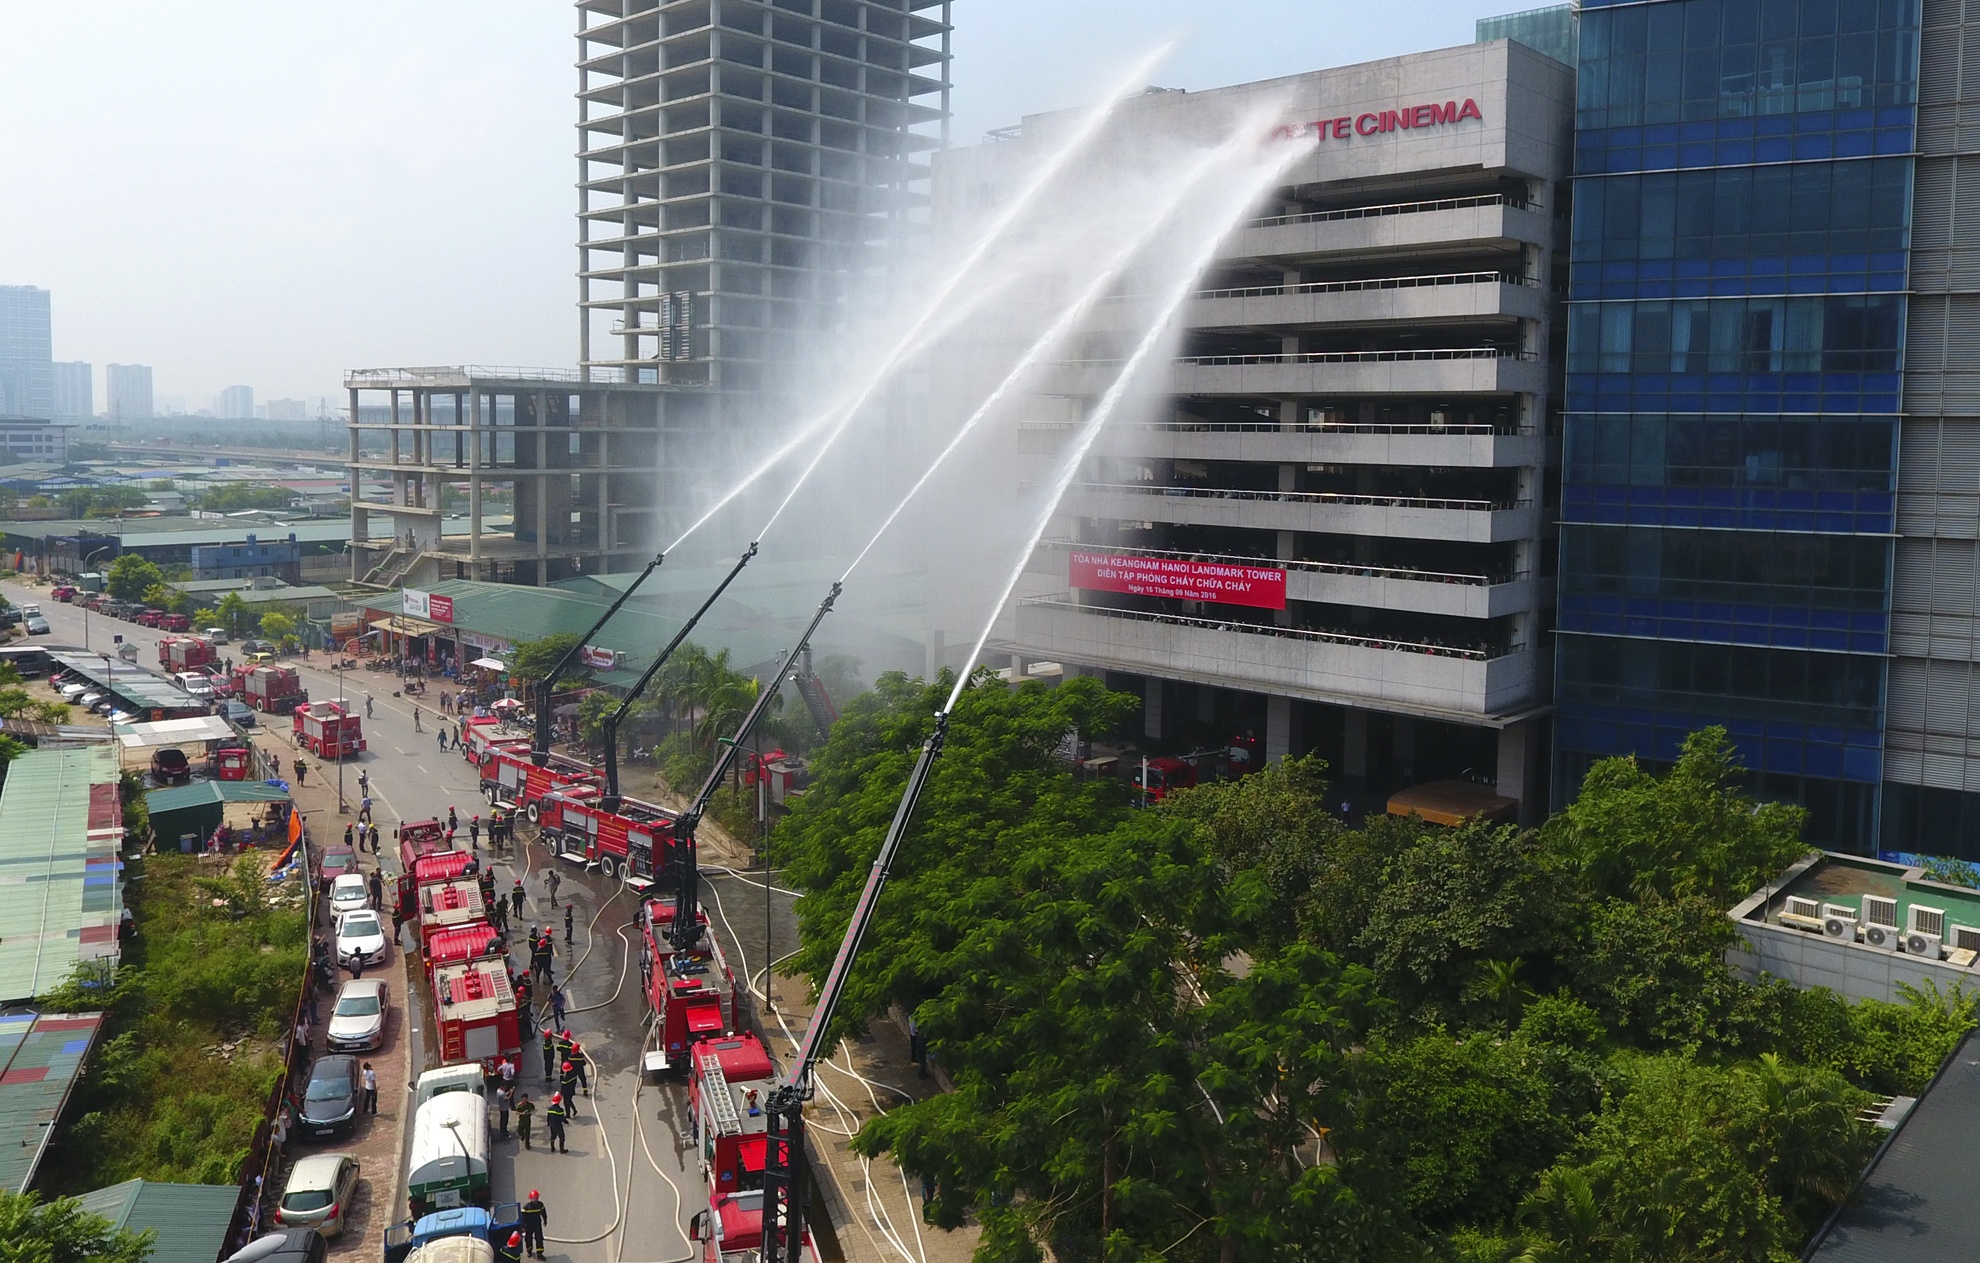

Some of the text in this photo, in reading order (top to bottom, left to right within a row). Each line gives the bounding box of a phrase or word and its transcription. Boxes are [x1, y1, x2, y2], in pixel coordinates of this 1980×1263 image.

[1355, 99, 1481, 136] CINEMA
[1073, 554, 1282, 581] TÒA NHÀ KEANGNAM HANOI LANDMARK TOWER
[1118, 570, 1135, 581] TẬP
[1137, 572, 1168, 584] PHÒNG
[1169, 575, 1194, 586] CHÁY
[1196, 578, 1223, 589] CHỮA
[1225, 580, 1251, 592] CHÁY
[1128, 584, 1217, 600] Ngày 16 Tháng 09 Năm 2016
